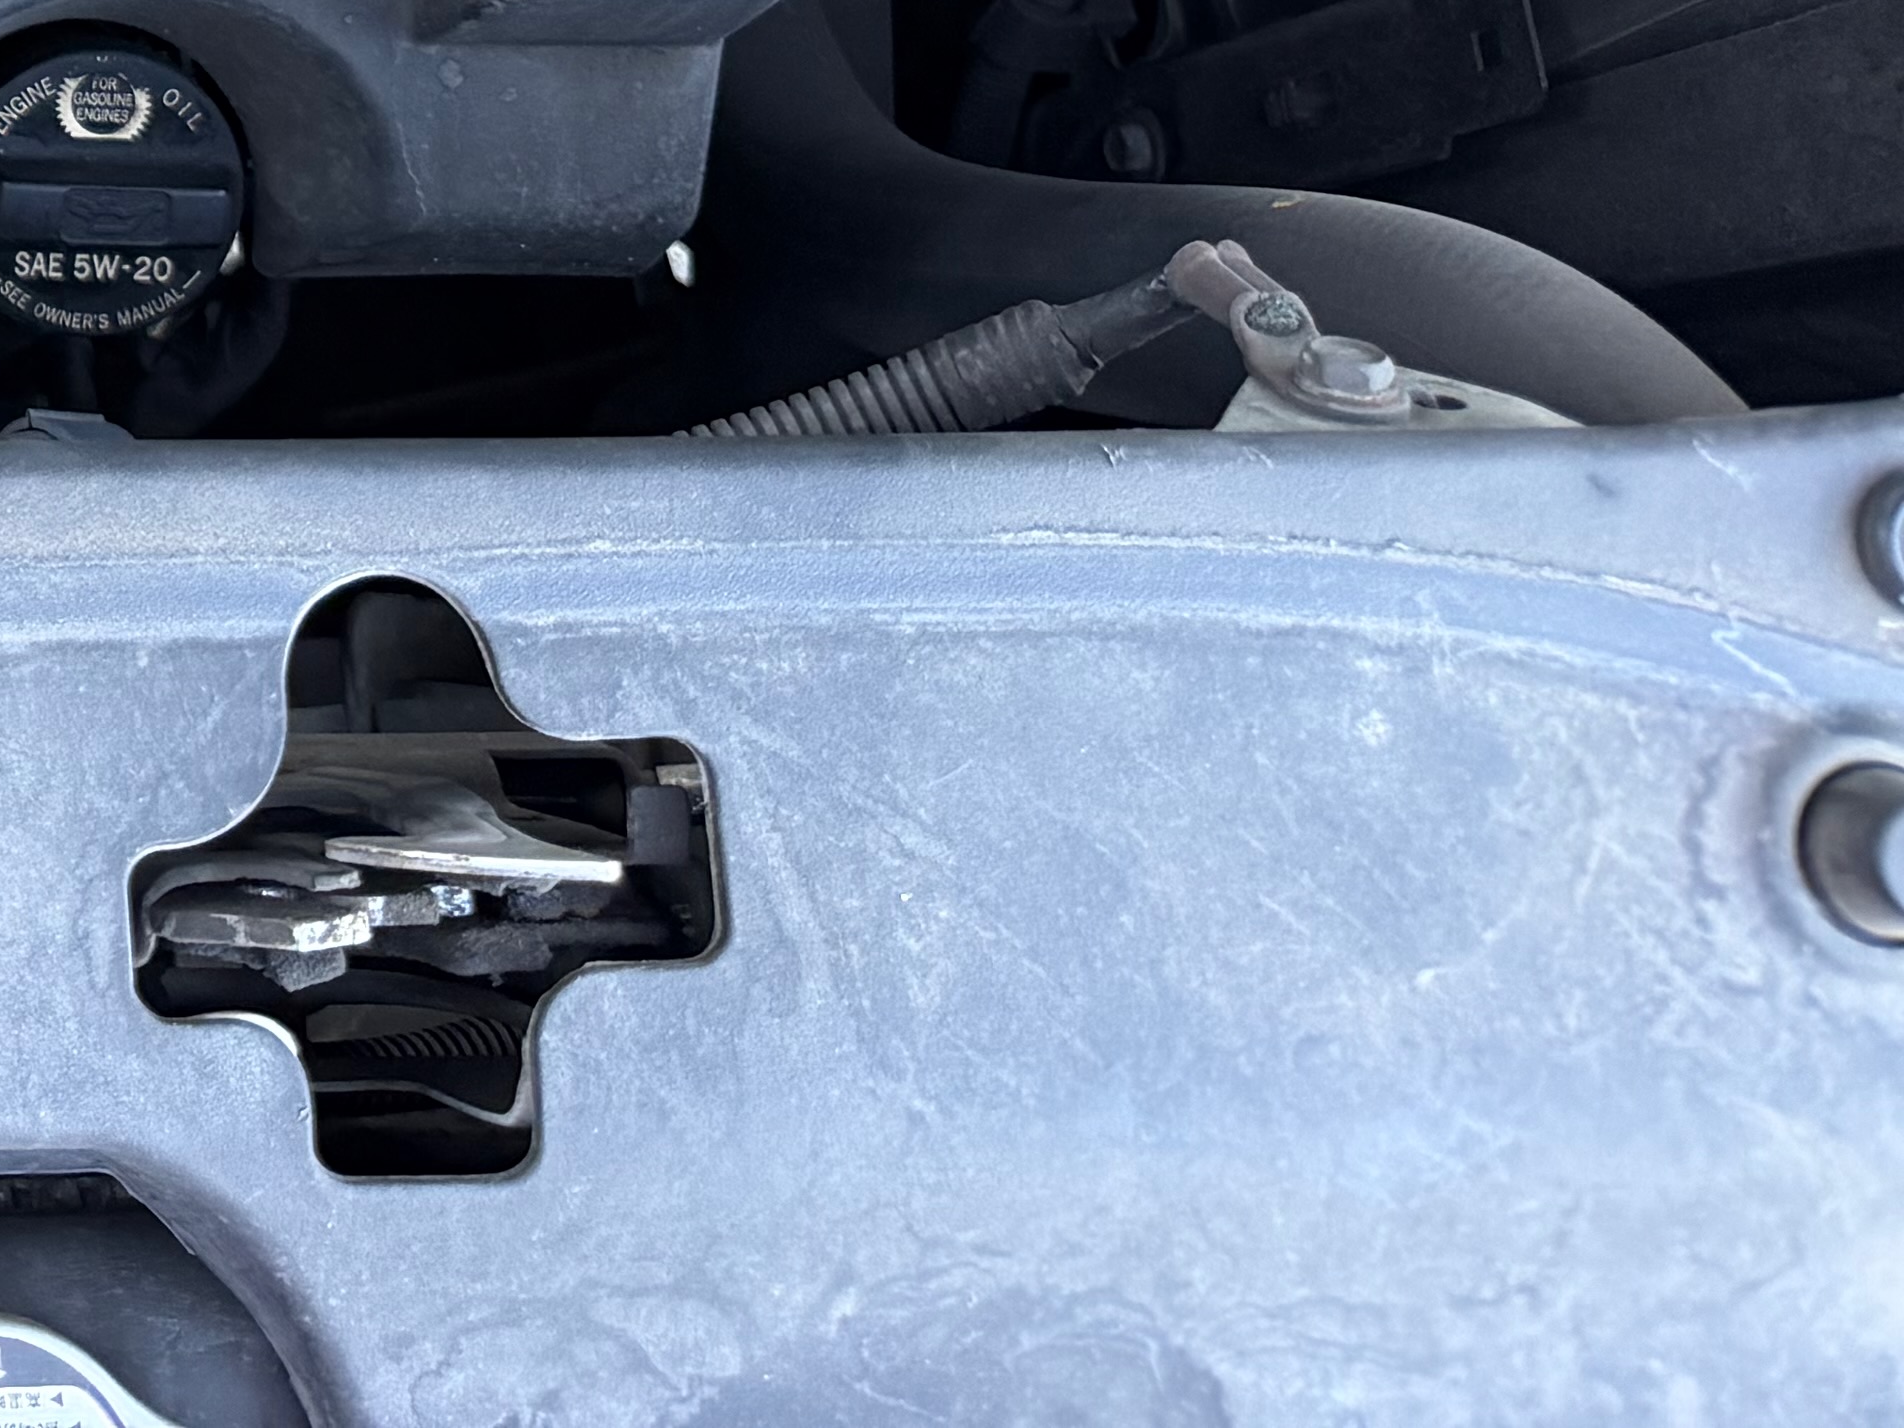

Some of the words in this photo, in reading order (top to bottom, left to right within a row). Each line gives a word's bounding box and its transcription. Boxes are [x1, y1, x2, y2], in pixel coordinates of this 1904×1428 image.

[73, 91, 134, 108] GASOLINE
[76, 107, 129, 123] ENGINES
[163, 88, 207, 133] OIL
[14, 251, 63, 279] SAE
[74, 254, 174, 282] 5W-20
[0, 280, 30, 309] SEE
[34, 302, 109, 330] OWNER'S
[118, 288, 185, 325] MANUAL
